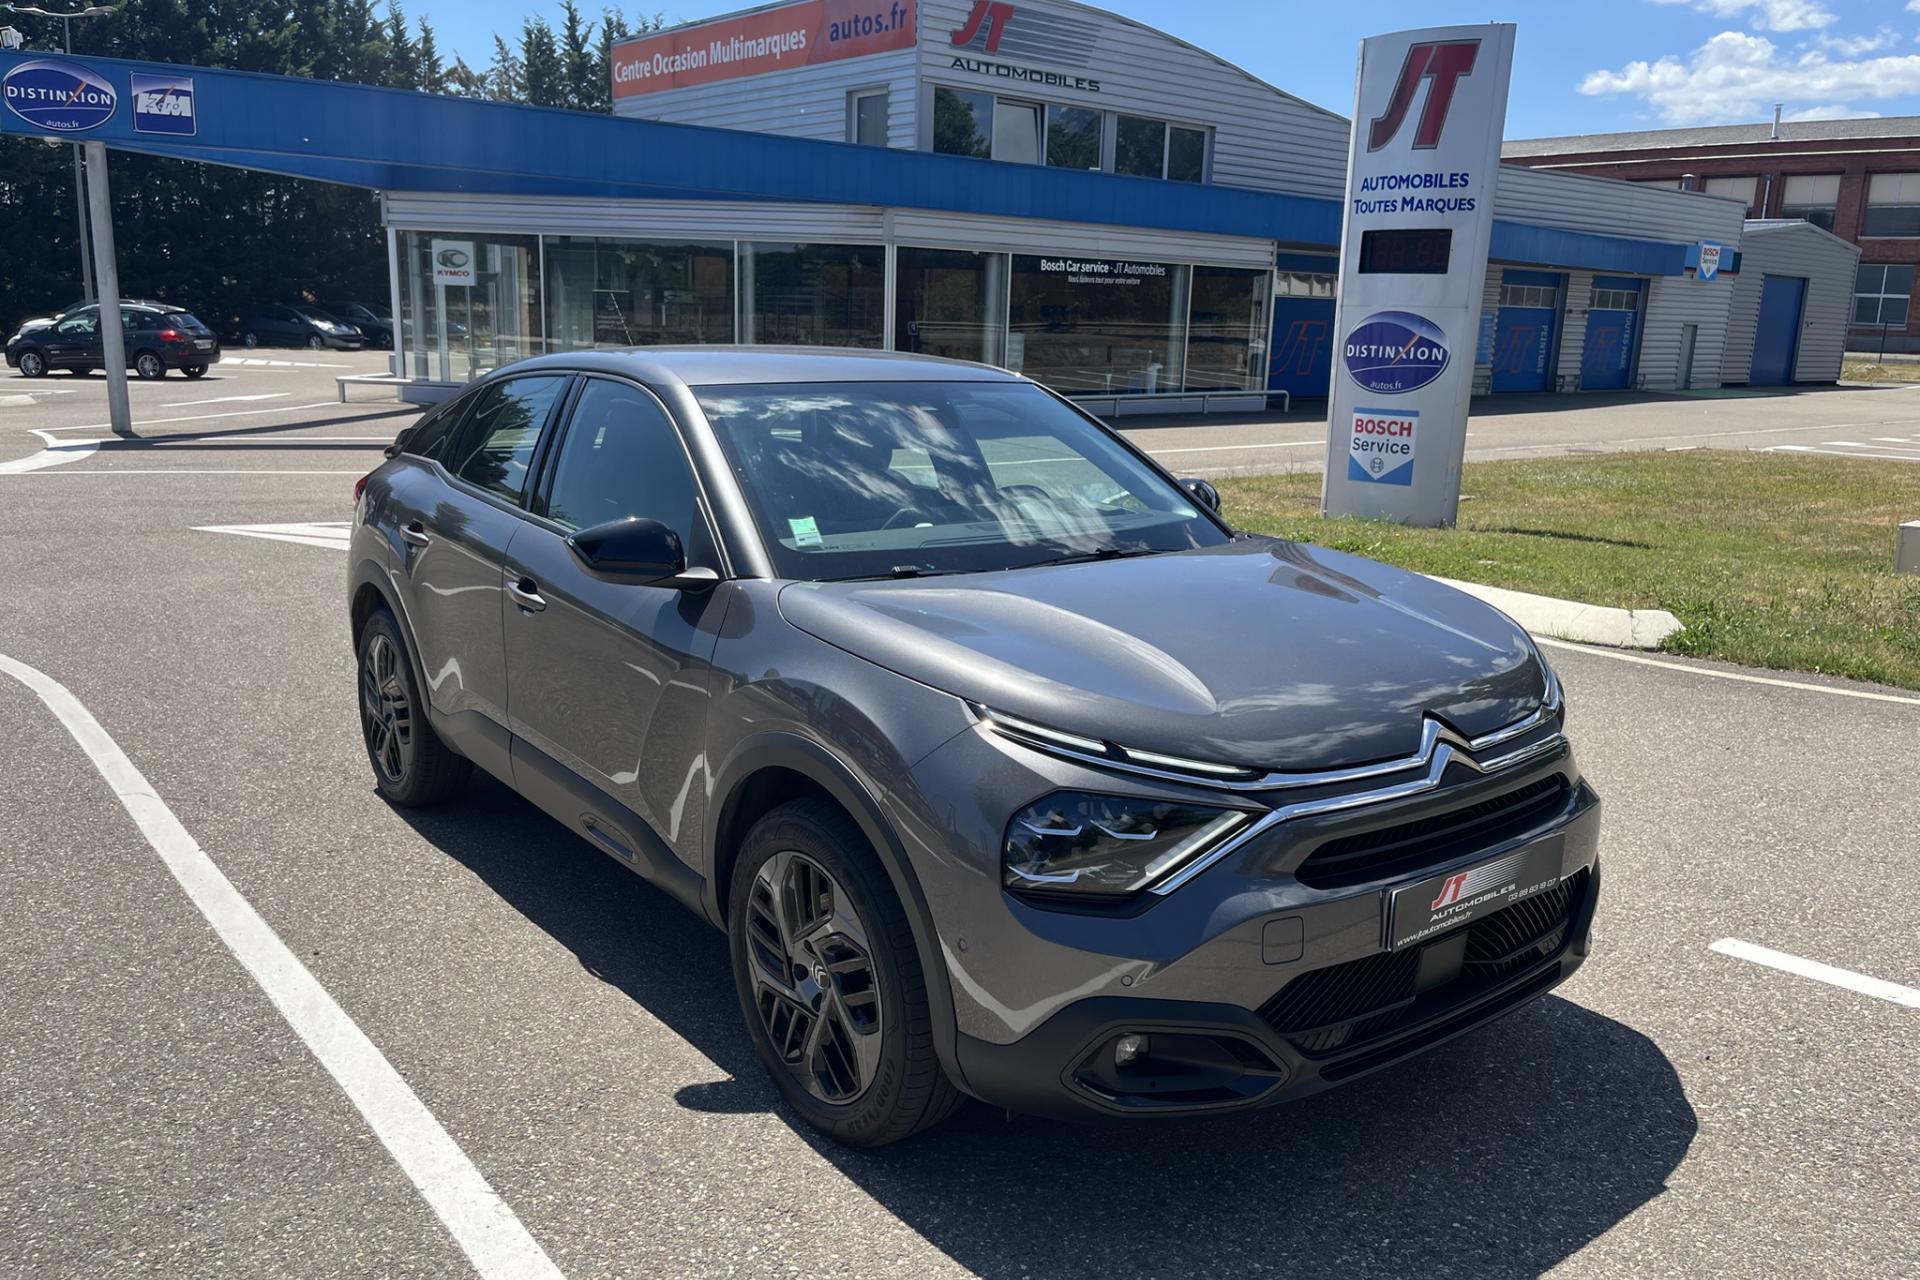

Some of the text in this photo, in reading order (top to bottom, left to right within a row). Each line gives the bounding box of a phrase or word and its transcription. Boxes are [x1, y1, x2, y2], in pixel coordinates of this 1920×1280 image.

[829, 1, 908, 42] autos.fr
[951, 0, 1016, 56] JT
[614, 29, 806, 83] Centre Occasion Multimarques
[951, 57, 1100, 92] AUTOMOBILES
[7, 86, 111, 105] DISTINXION
[1367, 38, 1482, 153] JT
[46, 119, 80, 129] autos.fr
[1361, 173, 1470, 193] AUTOMOBILES
[1040, 259, 1166, 276] Bosch Car service JT Automobiles
[1346, 344, 1444, 361] DISTINXION
[1370, 380, 1402, 390] autos.fr
[1354, 418, 1412, 437] BOSCH
[1352, 437, 1410, 455] Service
[1430, 871, 1469, 912] JT
[1429, 882, 1516, 923] AUTOMOBILES
